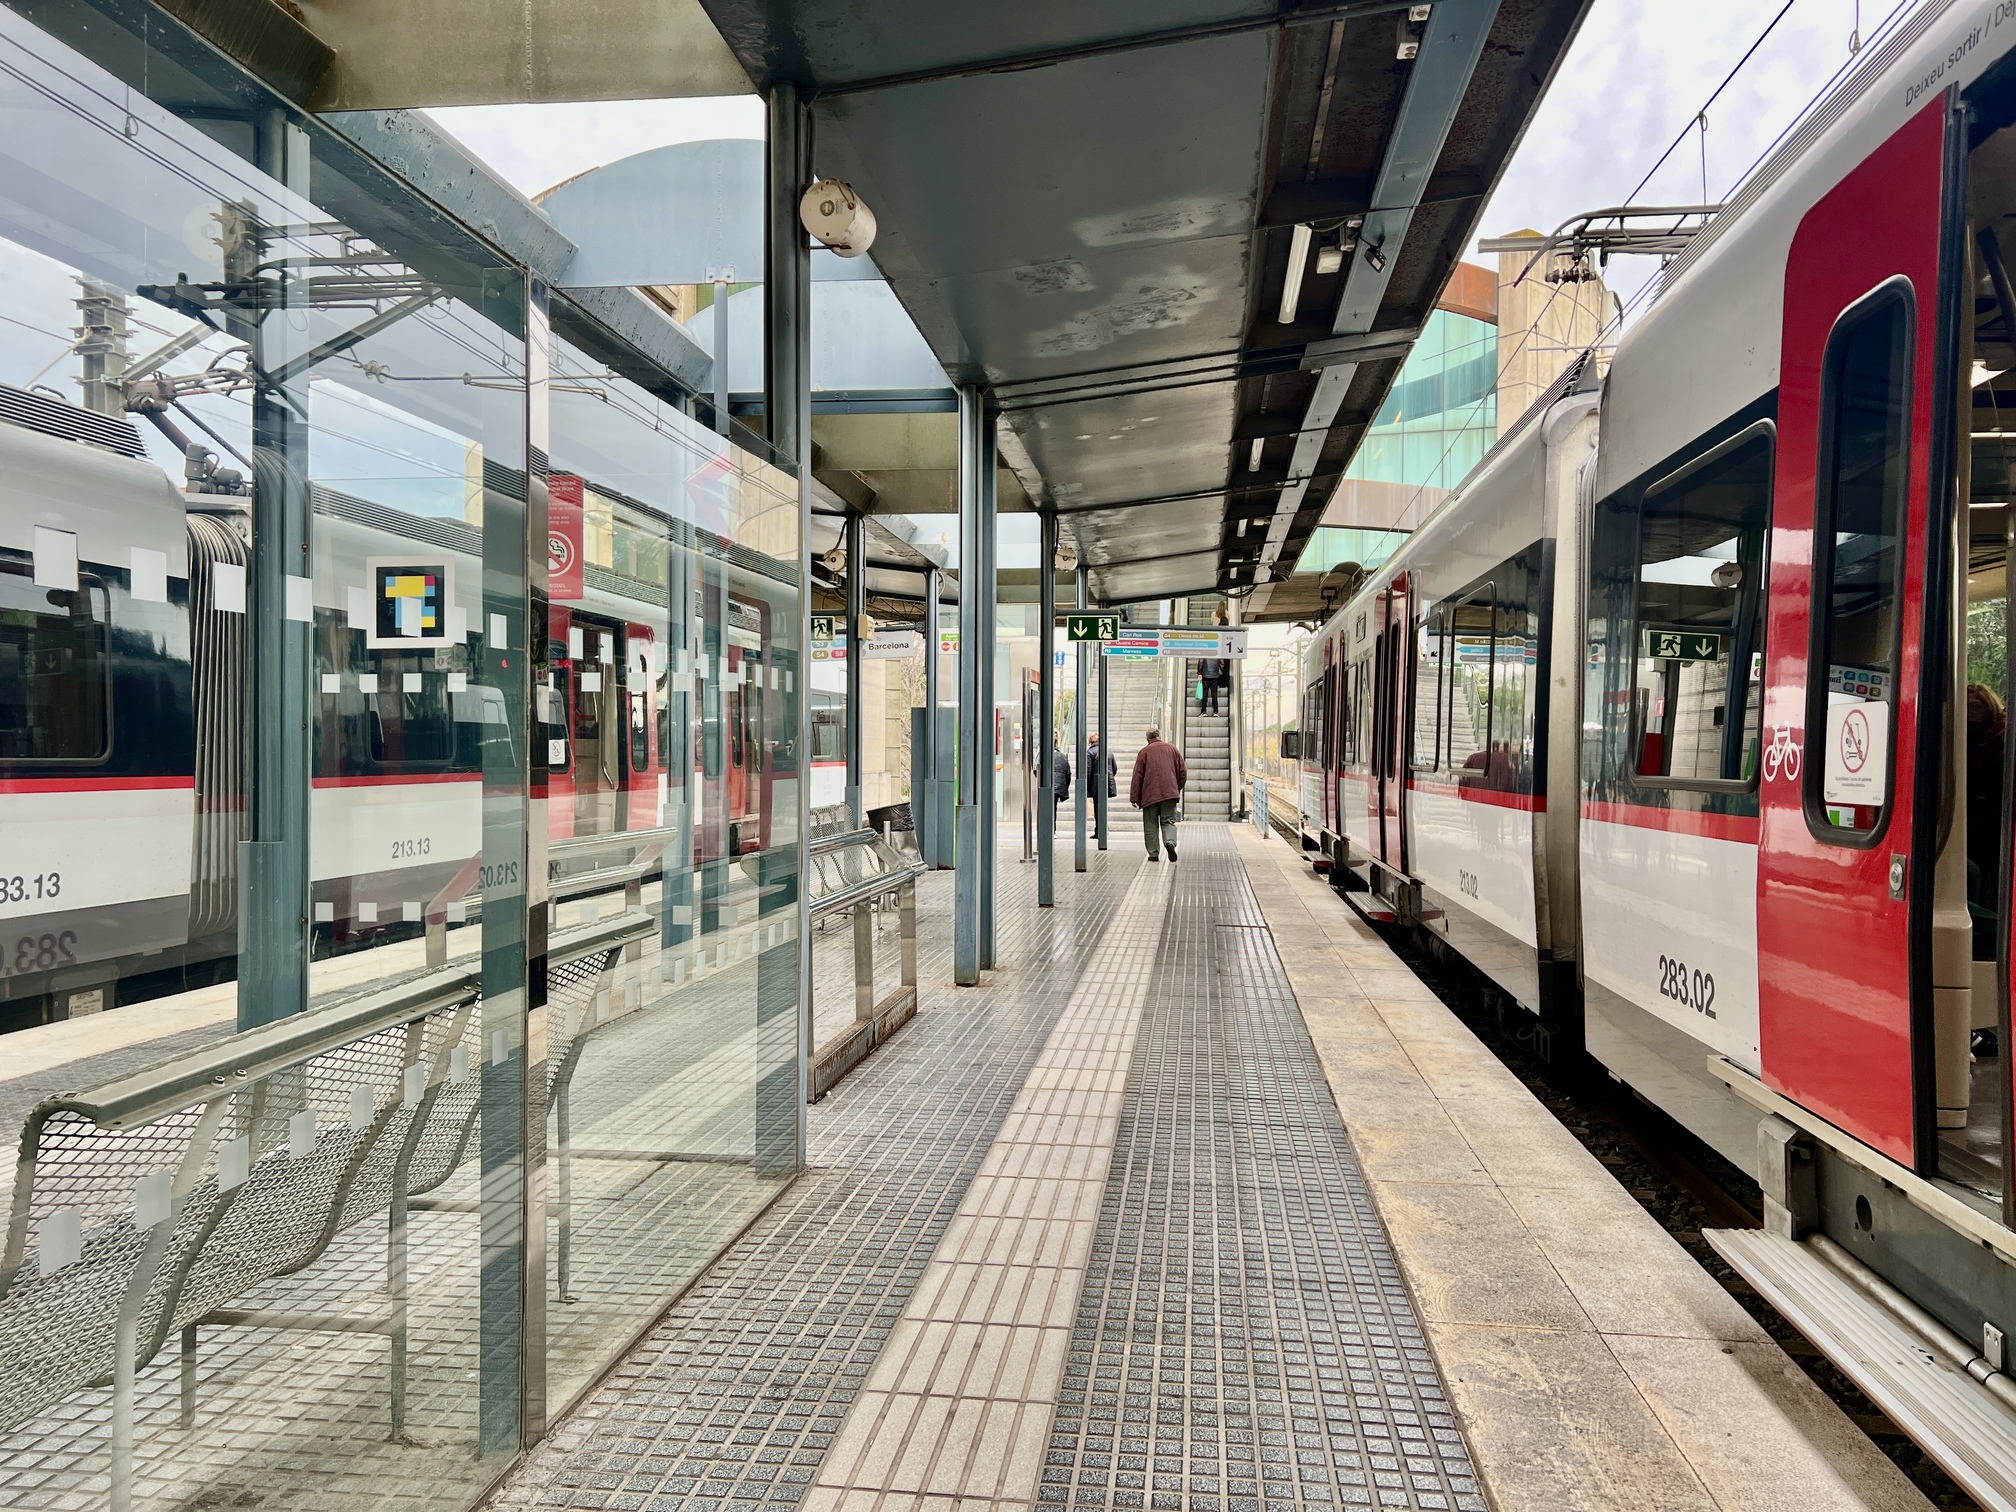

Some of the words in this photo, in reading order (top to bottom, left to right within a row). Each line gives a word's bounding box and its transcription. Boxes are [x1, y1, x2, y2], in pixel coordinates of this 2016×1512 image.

[1905, 61, 1945, 107] Deixeu
[1947, 27, 1982, 69] sortir
[1984, 13, 1992, 38] /
[868, 642, 910, 651] Barcelona
[1225, 641, 1232, 653] 1
[391, 837, 430, 859] 213.13
[1459, 868, 1478, 900] 213.02
[1659, 954, 1717, 1020] 283.02
